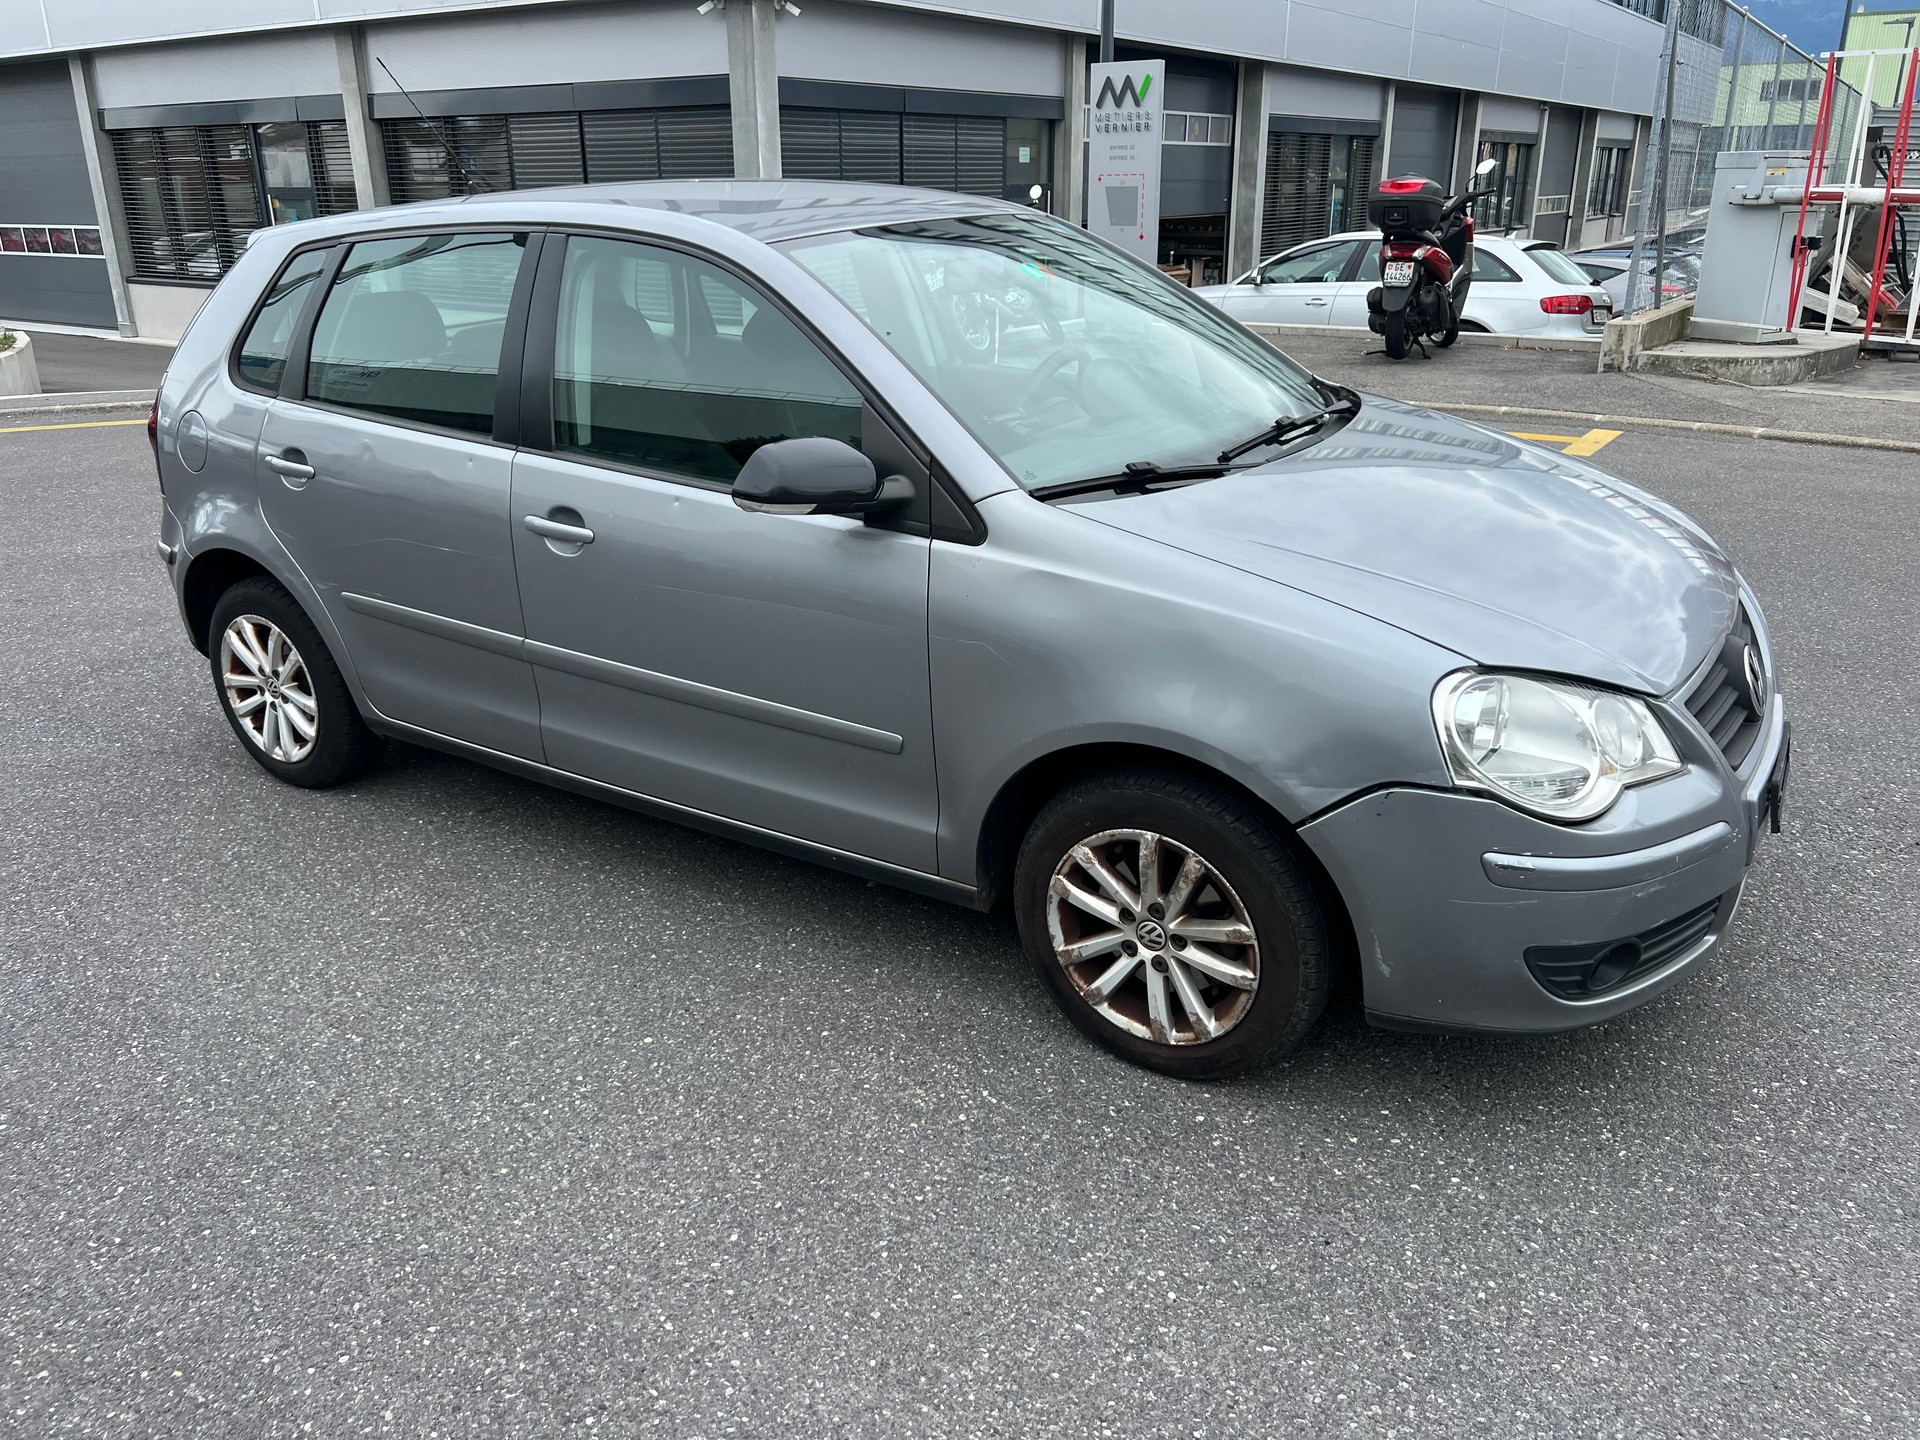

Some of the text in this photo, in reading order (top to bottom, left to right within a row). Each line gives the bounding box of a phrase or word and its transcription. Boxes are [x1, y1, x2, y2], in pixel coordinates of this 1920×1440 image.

[1095, 111, 1151, 122] METIERS
[1095, 122, 1151, 133] VERNIER
[1394, 263, 1405, 271] GE
[1386, 272, 1411, 281] 144266
